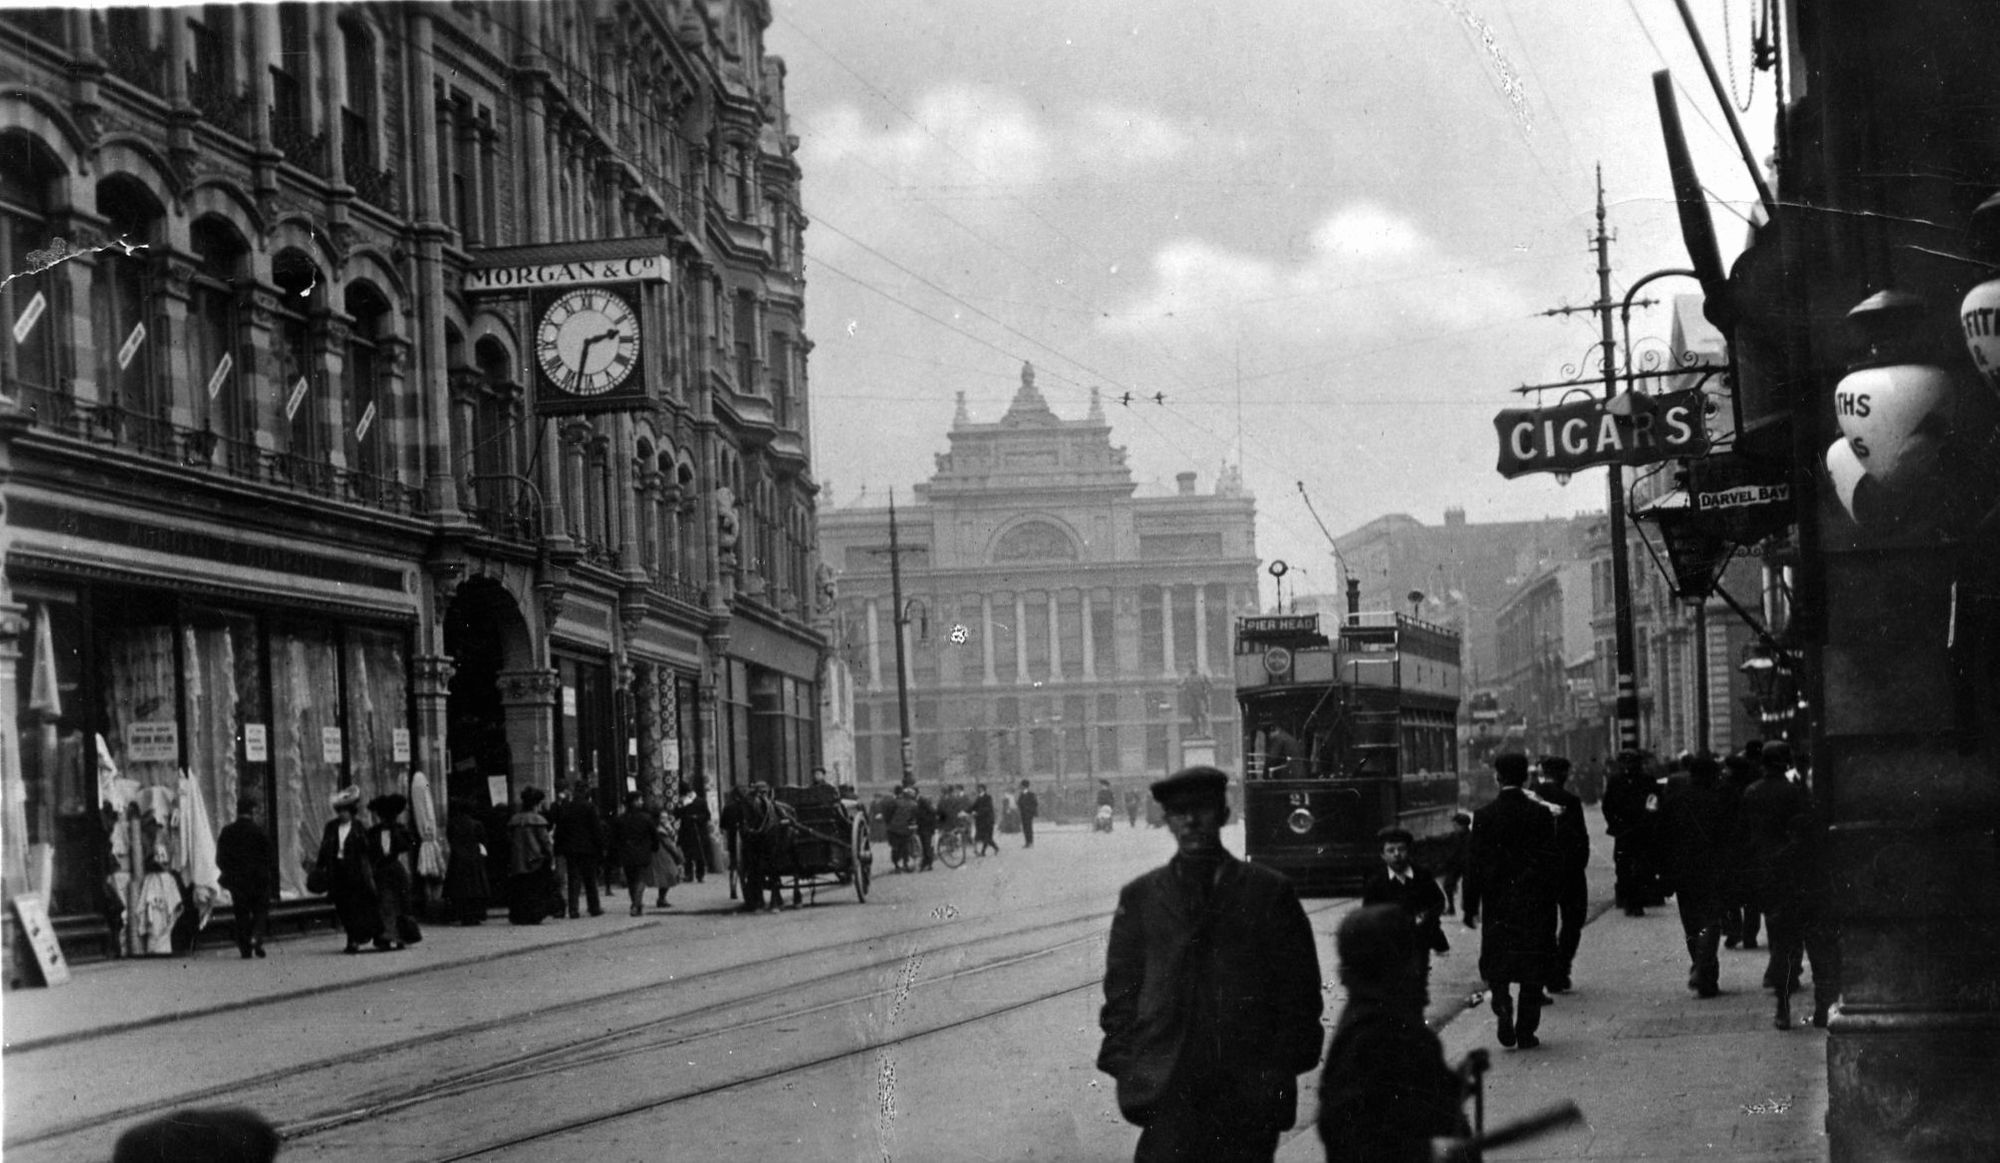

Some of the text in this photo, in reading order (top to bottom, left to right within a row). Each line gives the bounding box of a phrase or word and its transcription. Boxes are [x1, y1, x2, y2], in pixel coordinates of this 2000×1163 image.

[470, 262, 596, 287] MORGAN
[603, 263, 620, 279] &
[1511, 406, 1692, 461] CIGARS
[1701, 486, 1788, 507] DARVEL BAY
[1247, 618, 1314, 632] PIER HEAD
